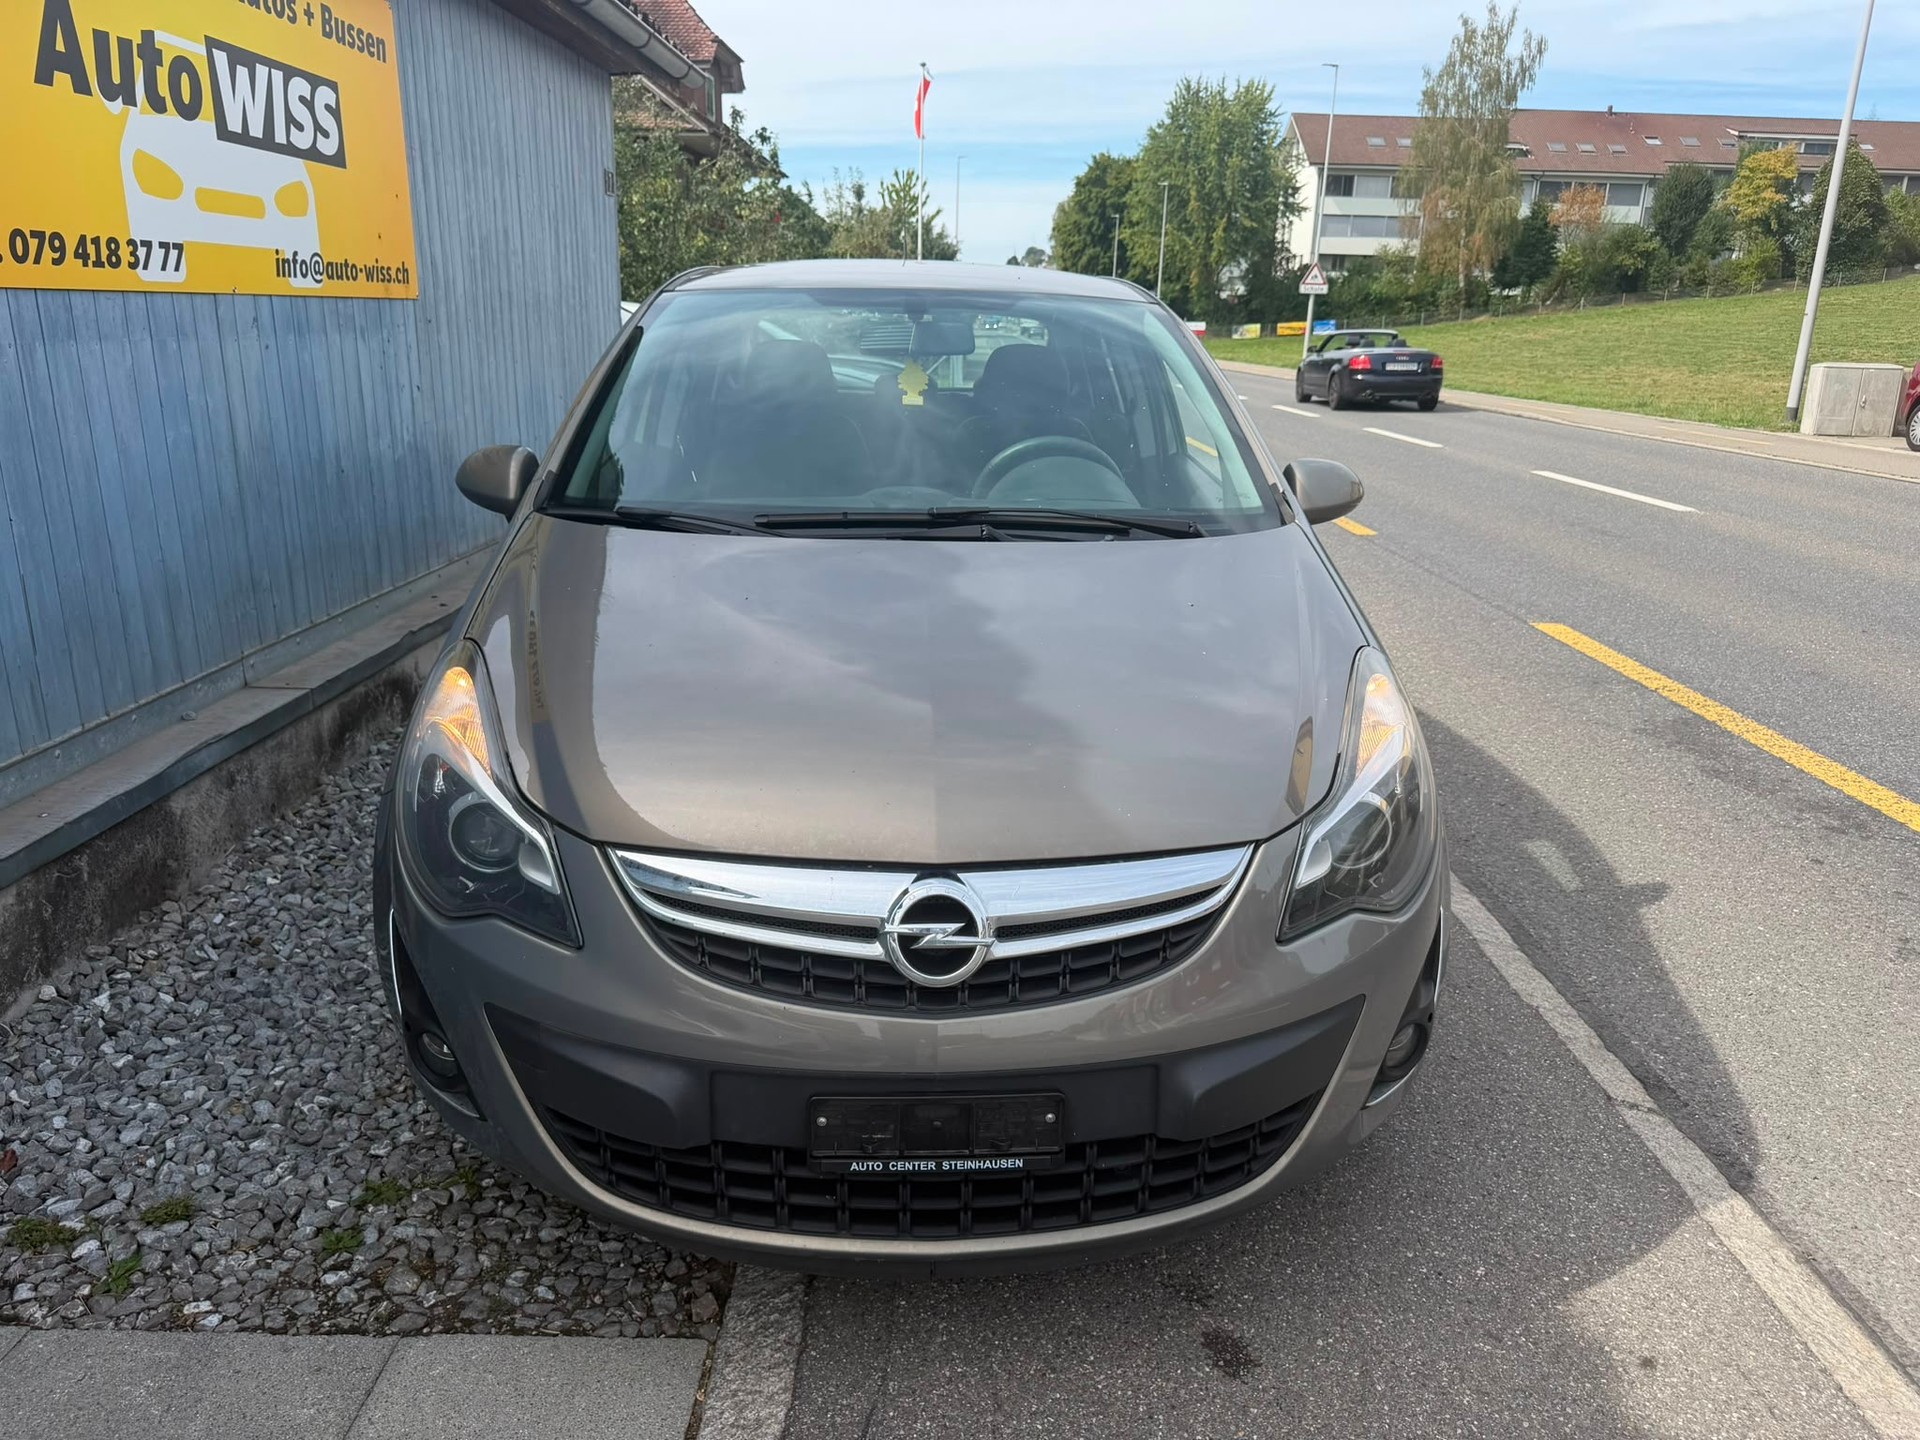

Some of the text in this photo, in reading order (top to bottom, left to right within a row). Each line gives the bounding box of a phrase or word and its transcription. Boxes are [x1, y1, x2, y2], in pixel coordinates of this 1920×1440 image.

[320, 3, 387, 63] Bussen
[34, 0, 340, 156] Auto WISS
[9, 228, 67, 266] 079
[73, 234, 122, 269] 418
[275, 249, 410, 285] info@auto-wiss.ch
[850, 1159, 1023, 1171] AUTO CENTER STEINHAUSEN
